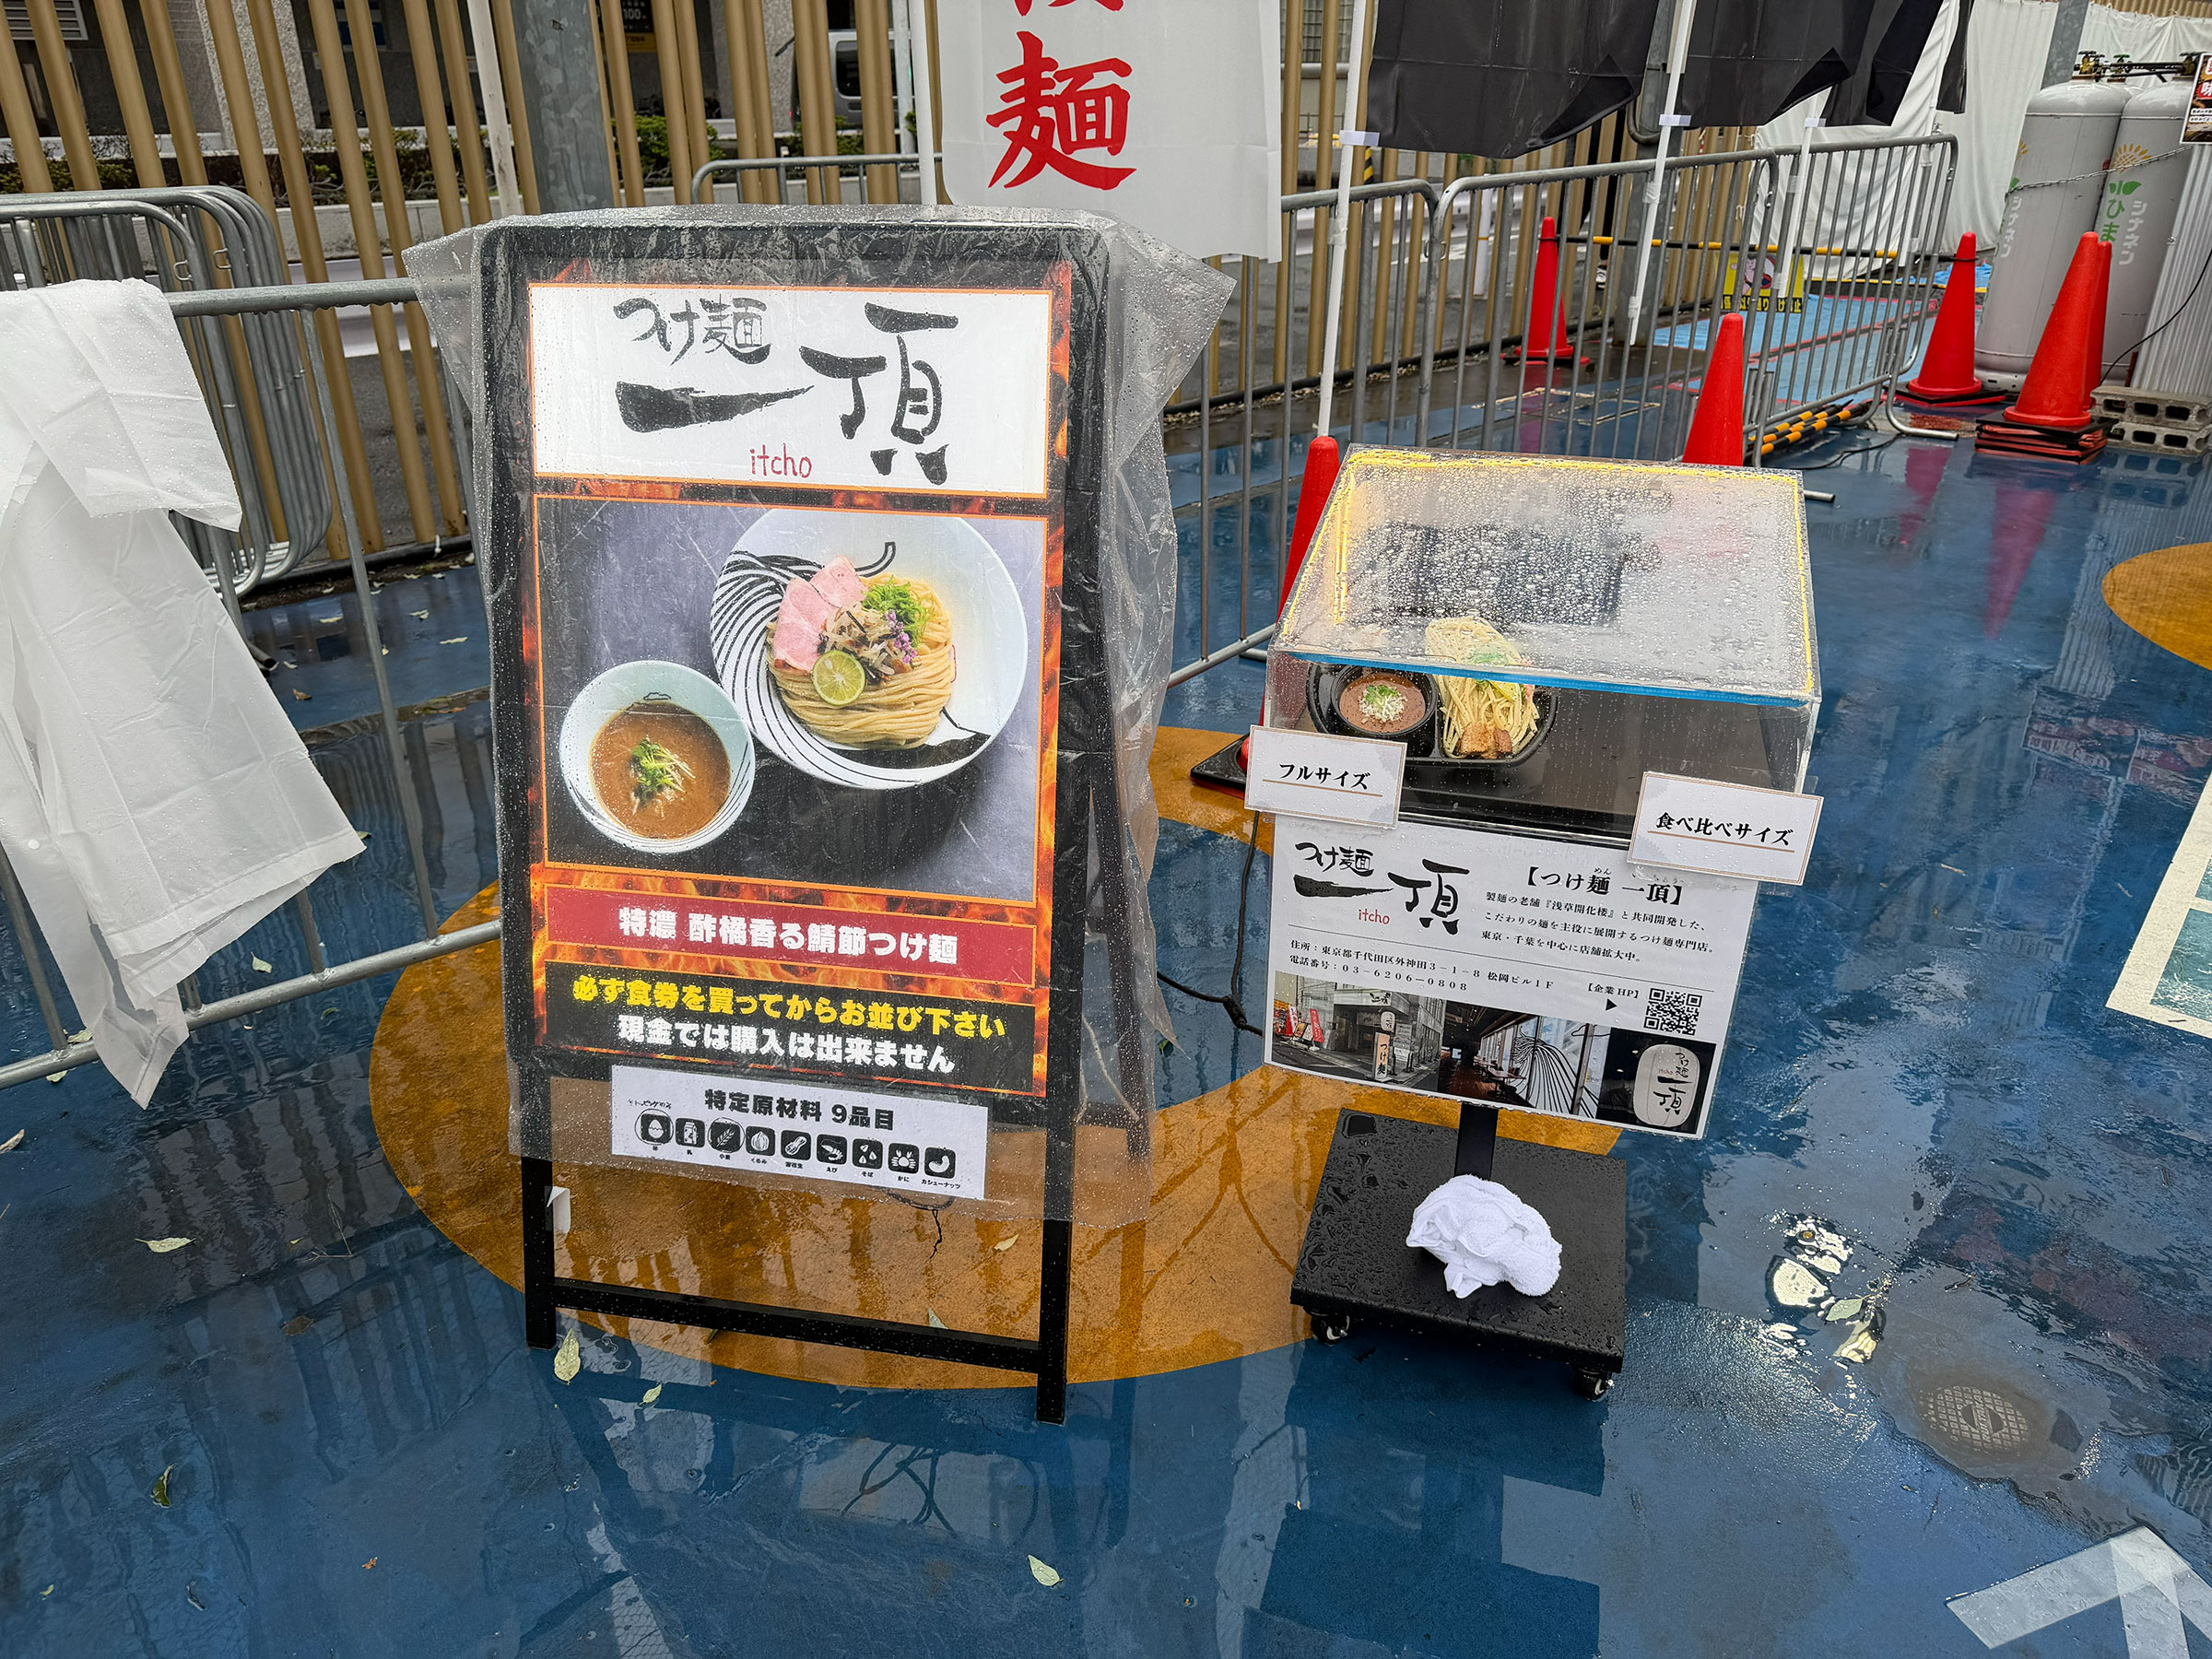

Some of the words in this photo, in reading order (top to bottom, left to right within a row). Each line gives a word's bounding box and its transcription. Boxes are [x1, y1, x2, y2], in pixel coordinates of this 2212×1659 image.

[986, 0, 1137, 191] 麺
[2001, 195, 2023, 258] シナネン
[2100, 198, 2125, 242] ひま
[2118, 200, 2148, 266] シナネン
[612, 294, 771, 367] つけ麺
[614, 301, 960, 486] 一頂
[748, 444, 813, 479] itcho
[1278, 762, 1371, 791] フルサイズ
[1655, 811, 1794, 847] 食べ比べサイズ
[1294, 841, 1374, 877] つけ麺
[1292, 858, 1470, 935] 一頂
[1358, 909, 1391, 925] itcho
[618, 906, 677, 940] 特濃
[688, 912, 959, 965] 酢橘香る鯖節つけ麺
[1480, 930, 1642, 963] 東京・千葉を中心に店舗拡大中。
[1484, 912, 1715, 954] こだわりの麺を主役に展開するつけ麺専門店。
[572, 975, 1006, 1040] 必ず食券を買ってからお並び下さい
[618, 1014, 957, 1075] 現金では購入は出来ません
[704, 1088, 822, 1123] 特定原材料
[830, 1104, 895, 1131] 9品目
[1653, 1076, 1693, 1115] 一頂
[921, 1179, 961, 1190] カシューナッツ
